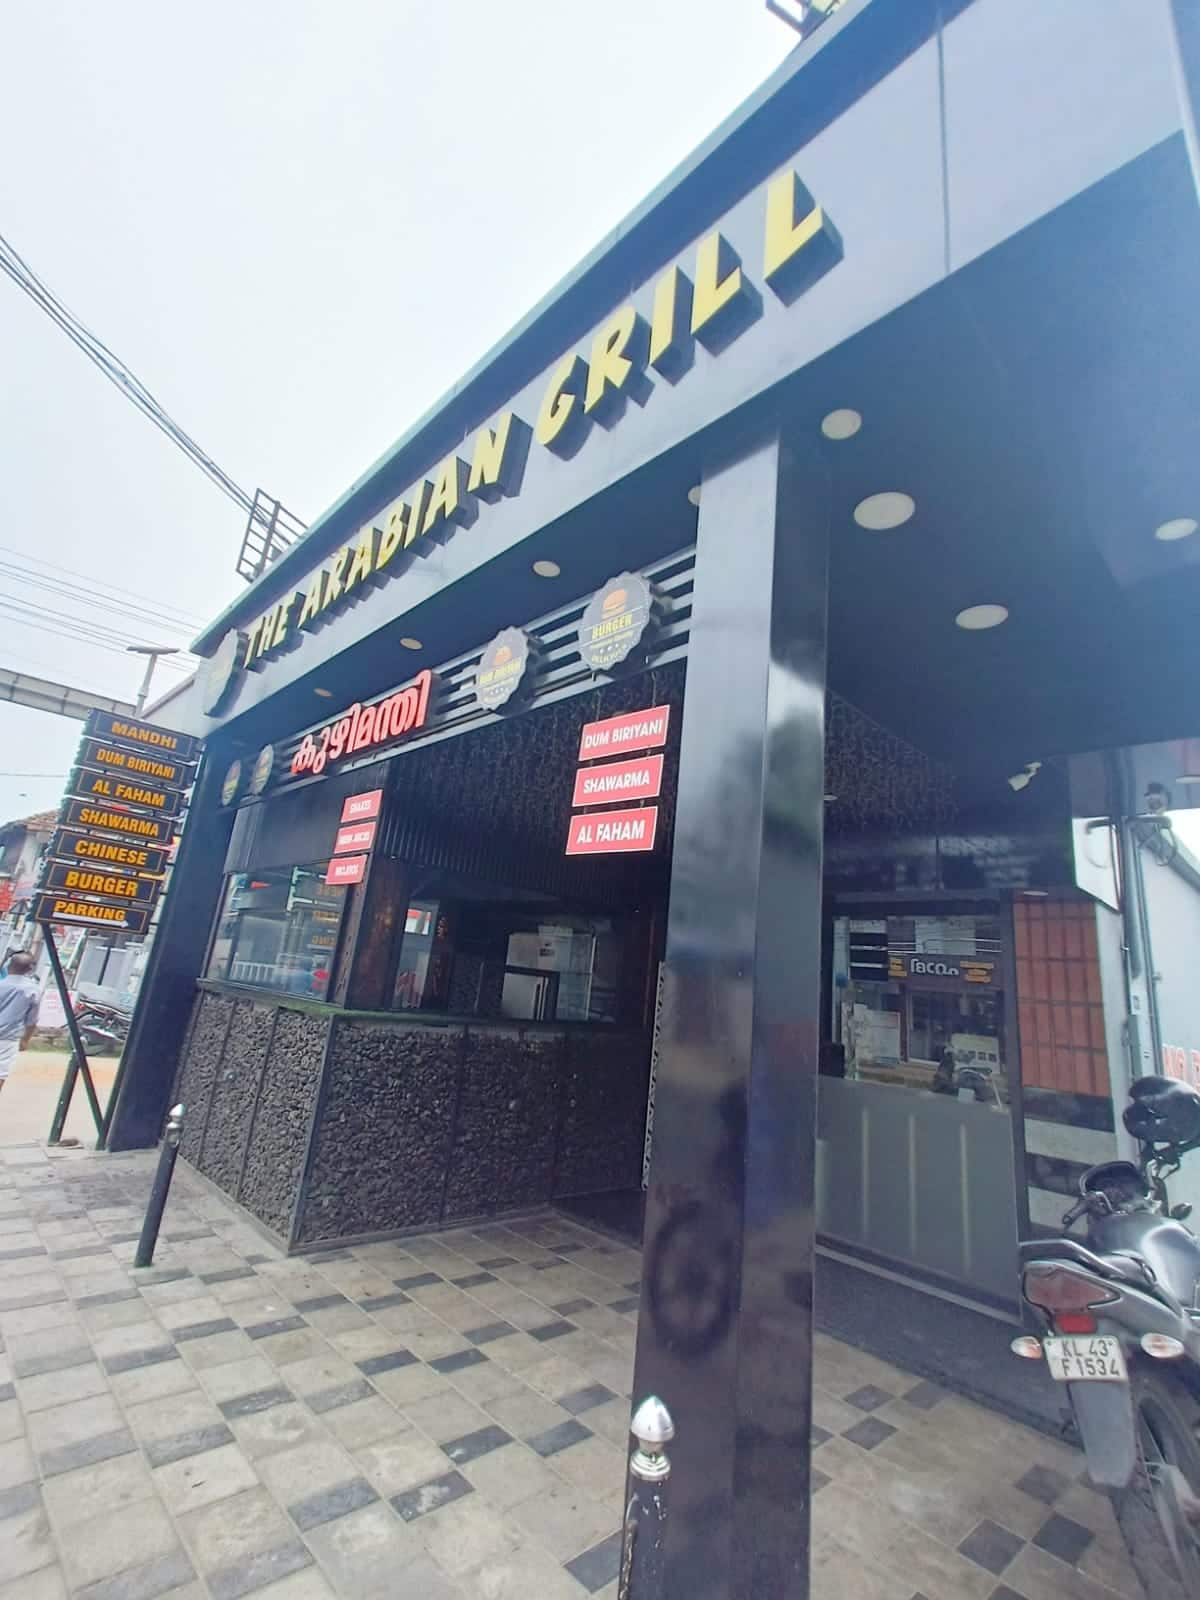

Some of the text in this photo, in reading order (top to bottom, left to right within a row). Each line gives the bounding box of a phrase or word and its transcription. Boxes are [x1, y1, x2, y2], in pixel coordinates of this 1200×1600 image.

[244, 168, 824, 669] THE ARABIAN GRILL
[111, 721, 177, 749] MANDHI
[584, 719, 663, 749] DUM BIRIYANI
[96, 748, 175, 779] DUM BIRIYANI
[92, 779, 165, 807] AL FAHAM
[583, 770, 650, 794] SHAWARMA
[79, 808, 159, 836] SHAWARMA
[577, 820, 645, 844] AL FAHAM
[74, 839, 149, 866] CHINESE
[65, 871, 138, 897] BURGER
[54, 900, 126, 921] PARKING
[1061, 1339, 1109, 1358] KL 43
